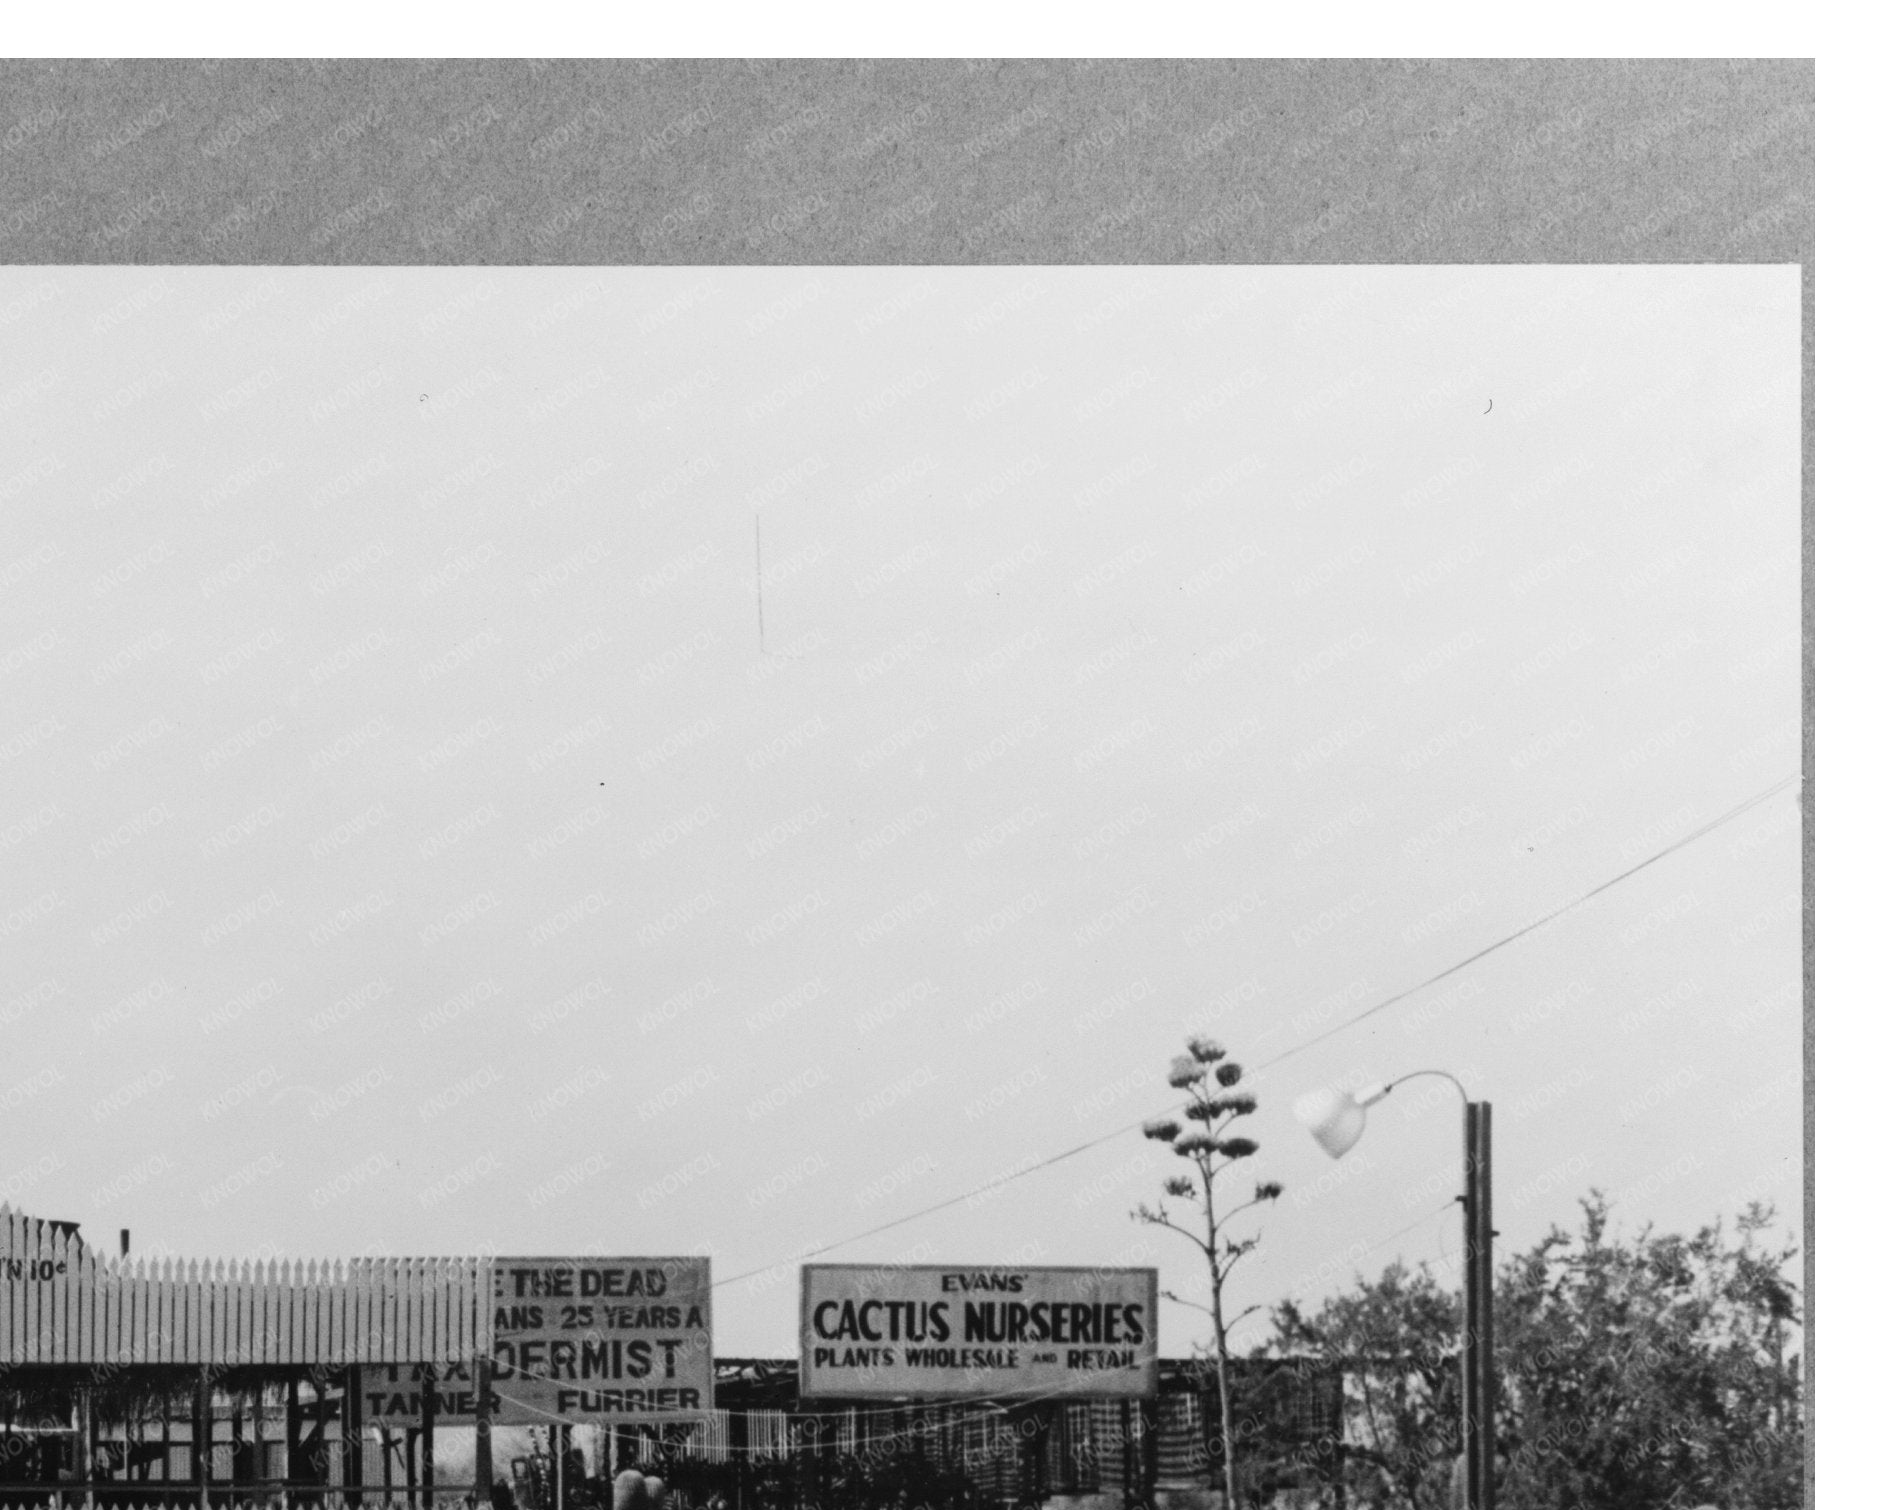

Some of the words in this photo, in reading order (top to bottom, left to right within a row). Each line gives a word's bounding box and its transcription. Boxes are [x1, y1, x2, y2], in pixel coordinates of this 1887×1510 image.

[510, 1268, 574, 1298] THE
[580, 1268, 668, 1298] DEAD
[561, 1305, 594, 1330] 25
[603, 1305, 682, 1330] YEARS
[685, 1304, 704, 1329] A
[813, 1298, 950, 1342] CACTUS
[964, 1300, 1144, 1345] NURSERIES
[814, 1347, 895, 1369] PLANTS
[905, 1348, 1019, 1370] WHOLESALE
[1031, 1352, 1058, 1364] AND
[1066, 1349, 1141, 1370] RETAIL
[558, 1387, 700, 1414] FURRIER
